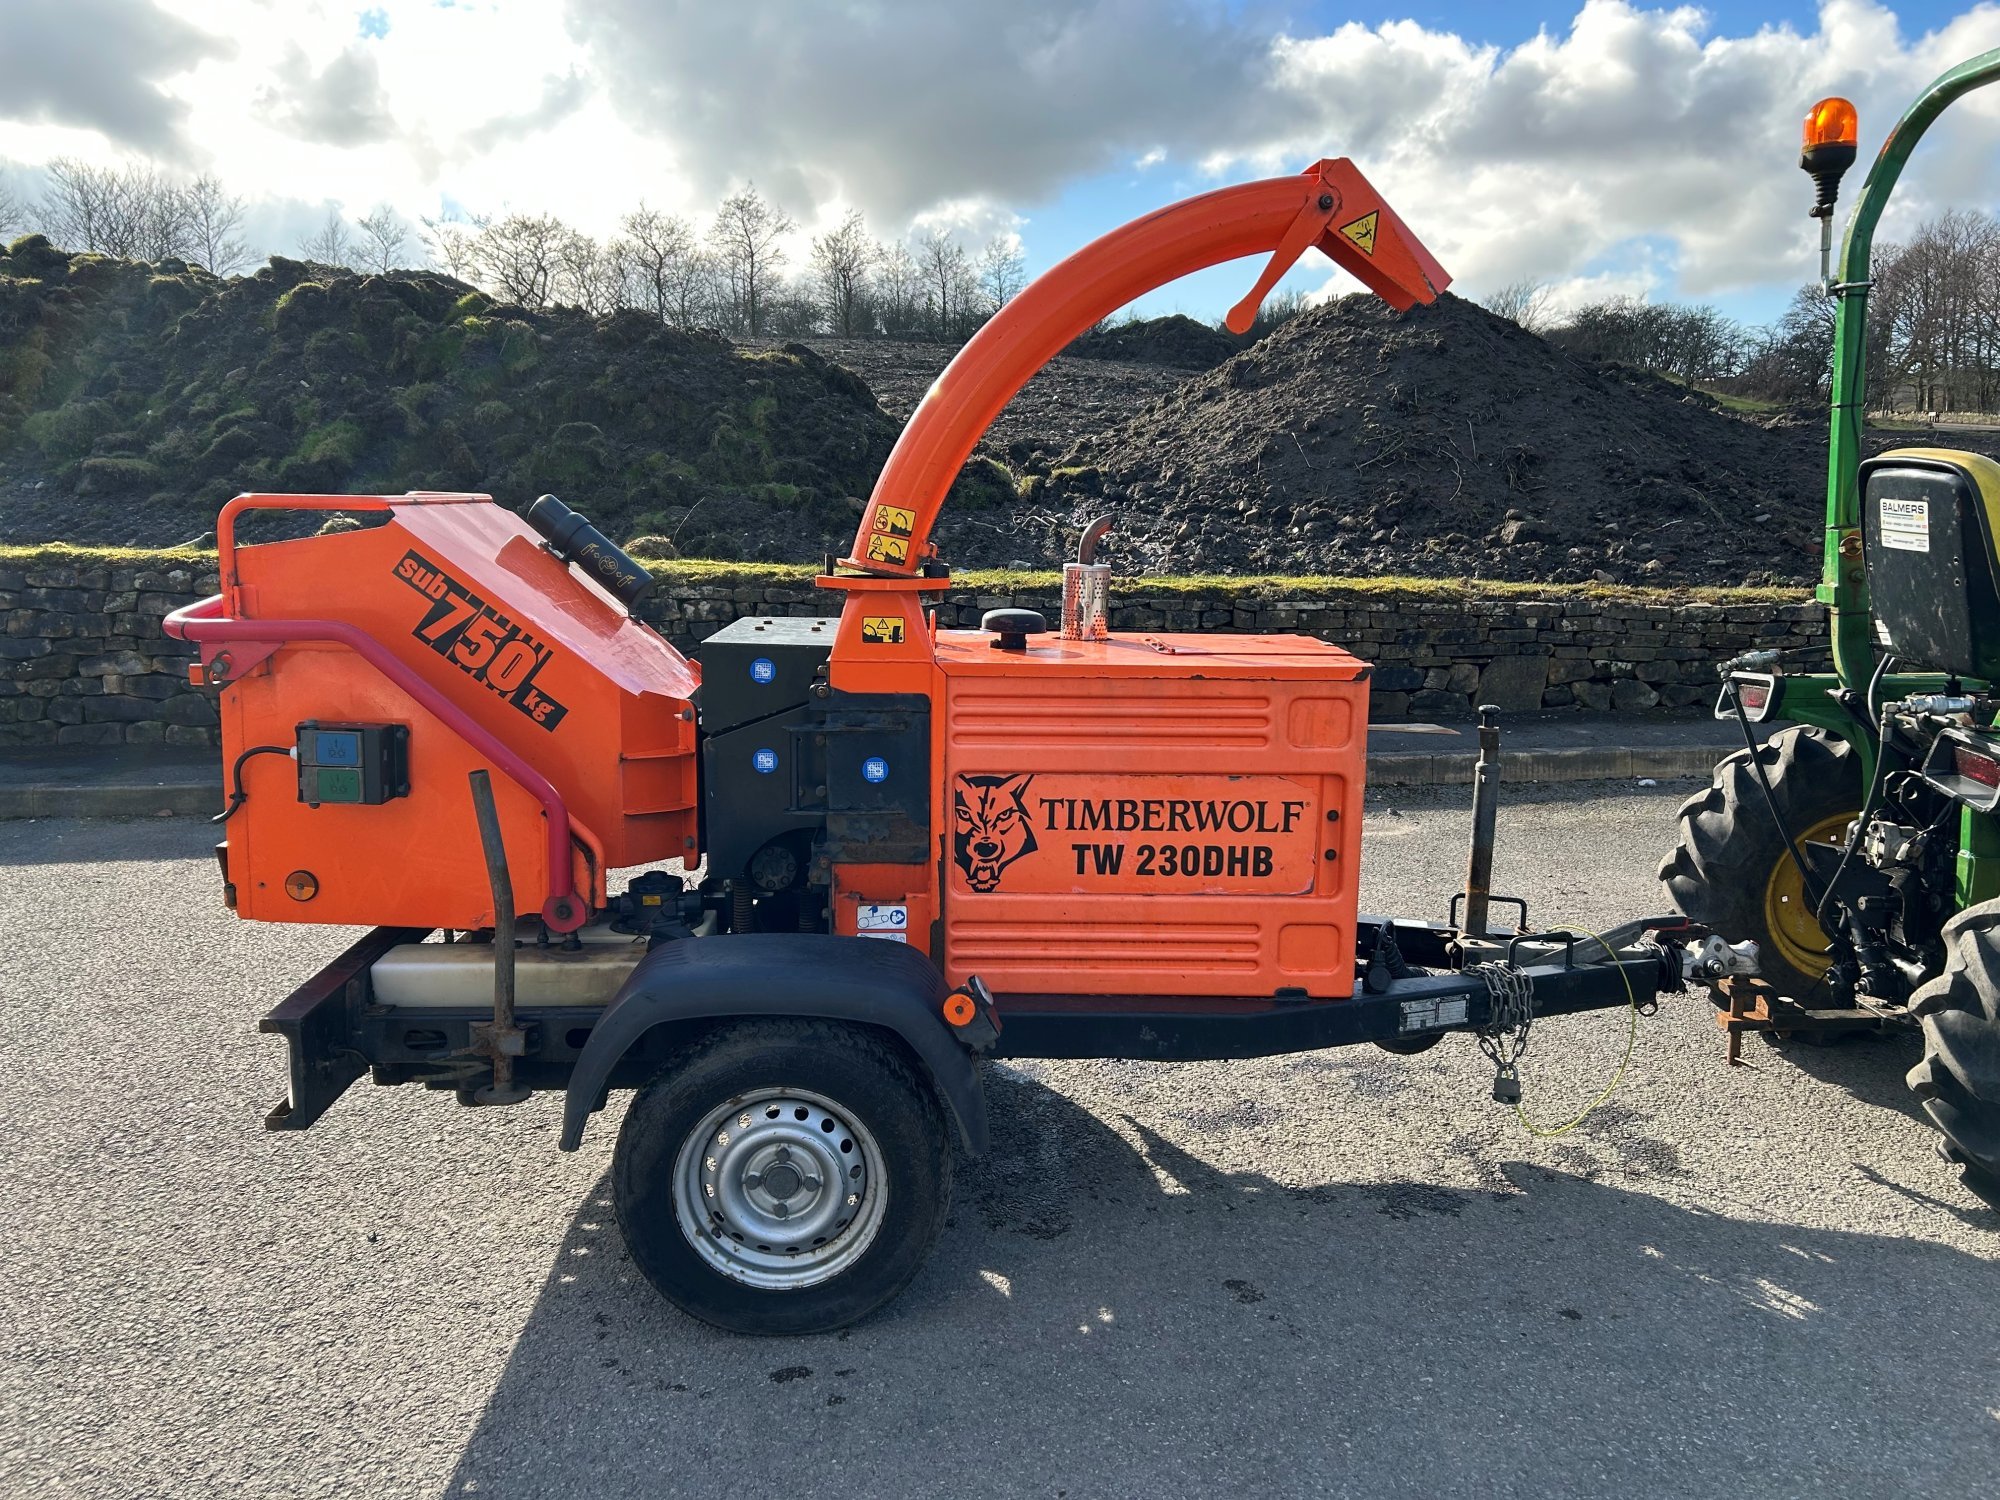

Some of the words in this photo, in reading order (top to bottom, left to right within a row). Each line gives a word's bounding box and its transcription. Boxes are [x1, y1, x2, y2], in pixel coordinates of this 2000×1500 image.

[1882, 502, 1925, 514] BALMERS
[398, 558, 448, 600] sub
[420, 591, 538, 693] 750
[523, 688, 555, 722] kg
[1072, 844, 1125, 875] TW
[1136, 844, 1274, 877] 230DHB
